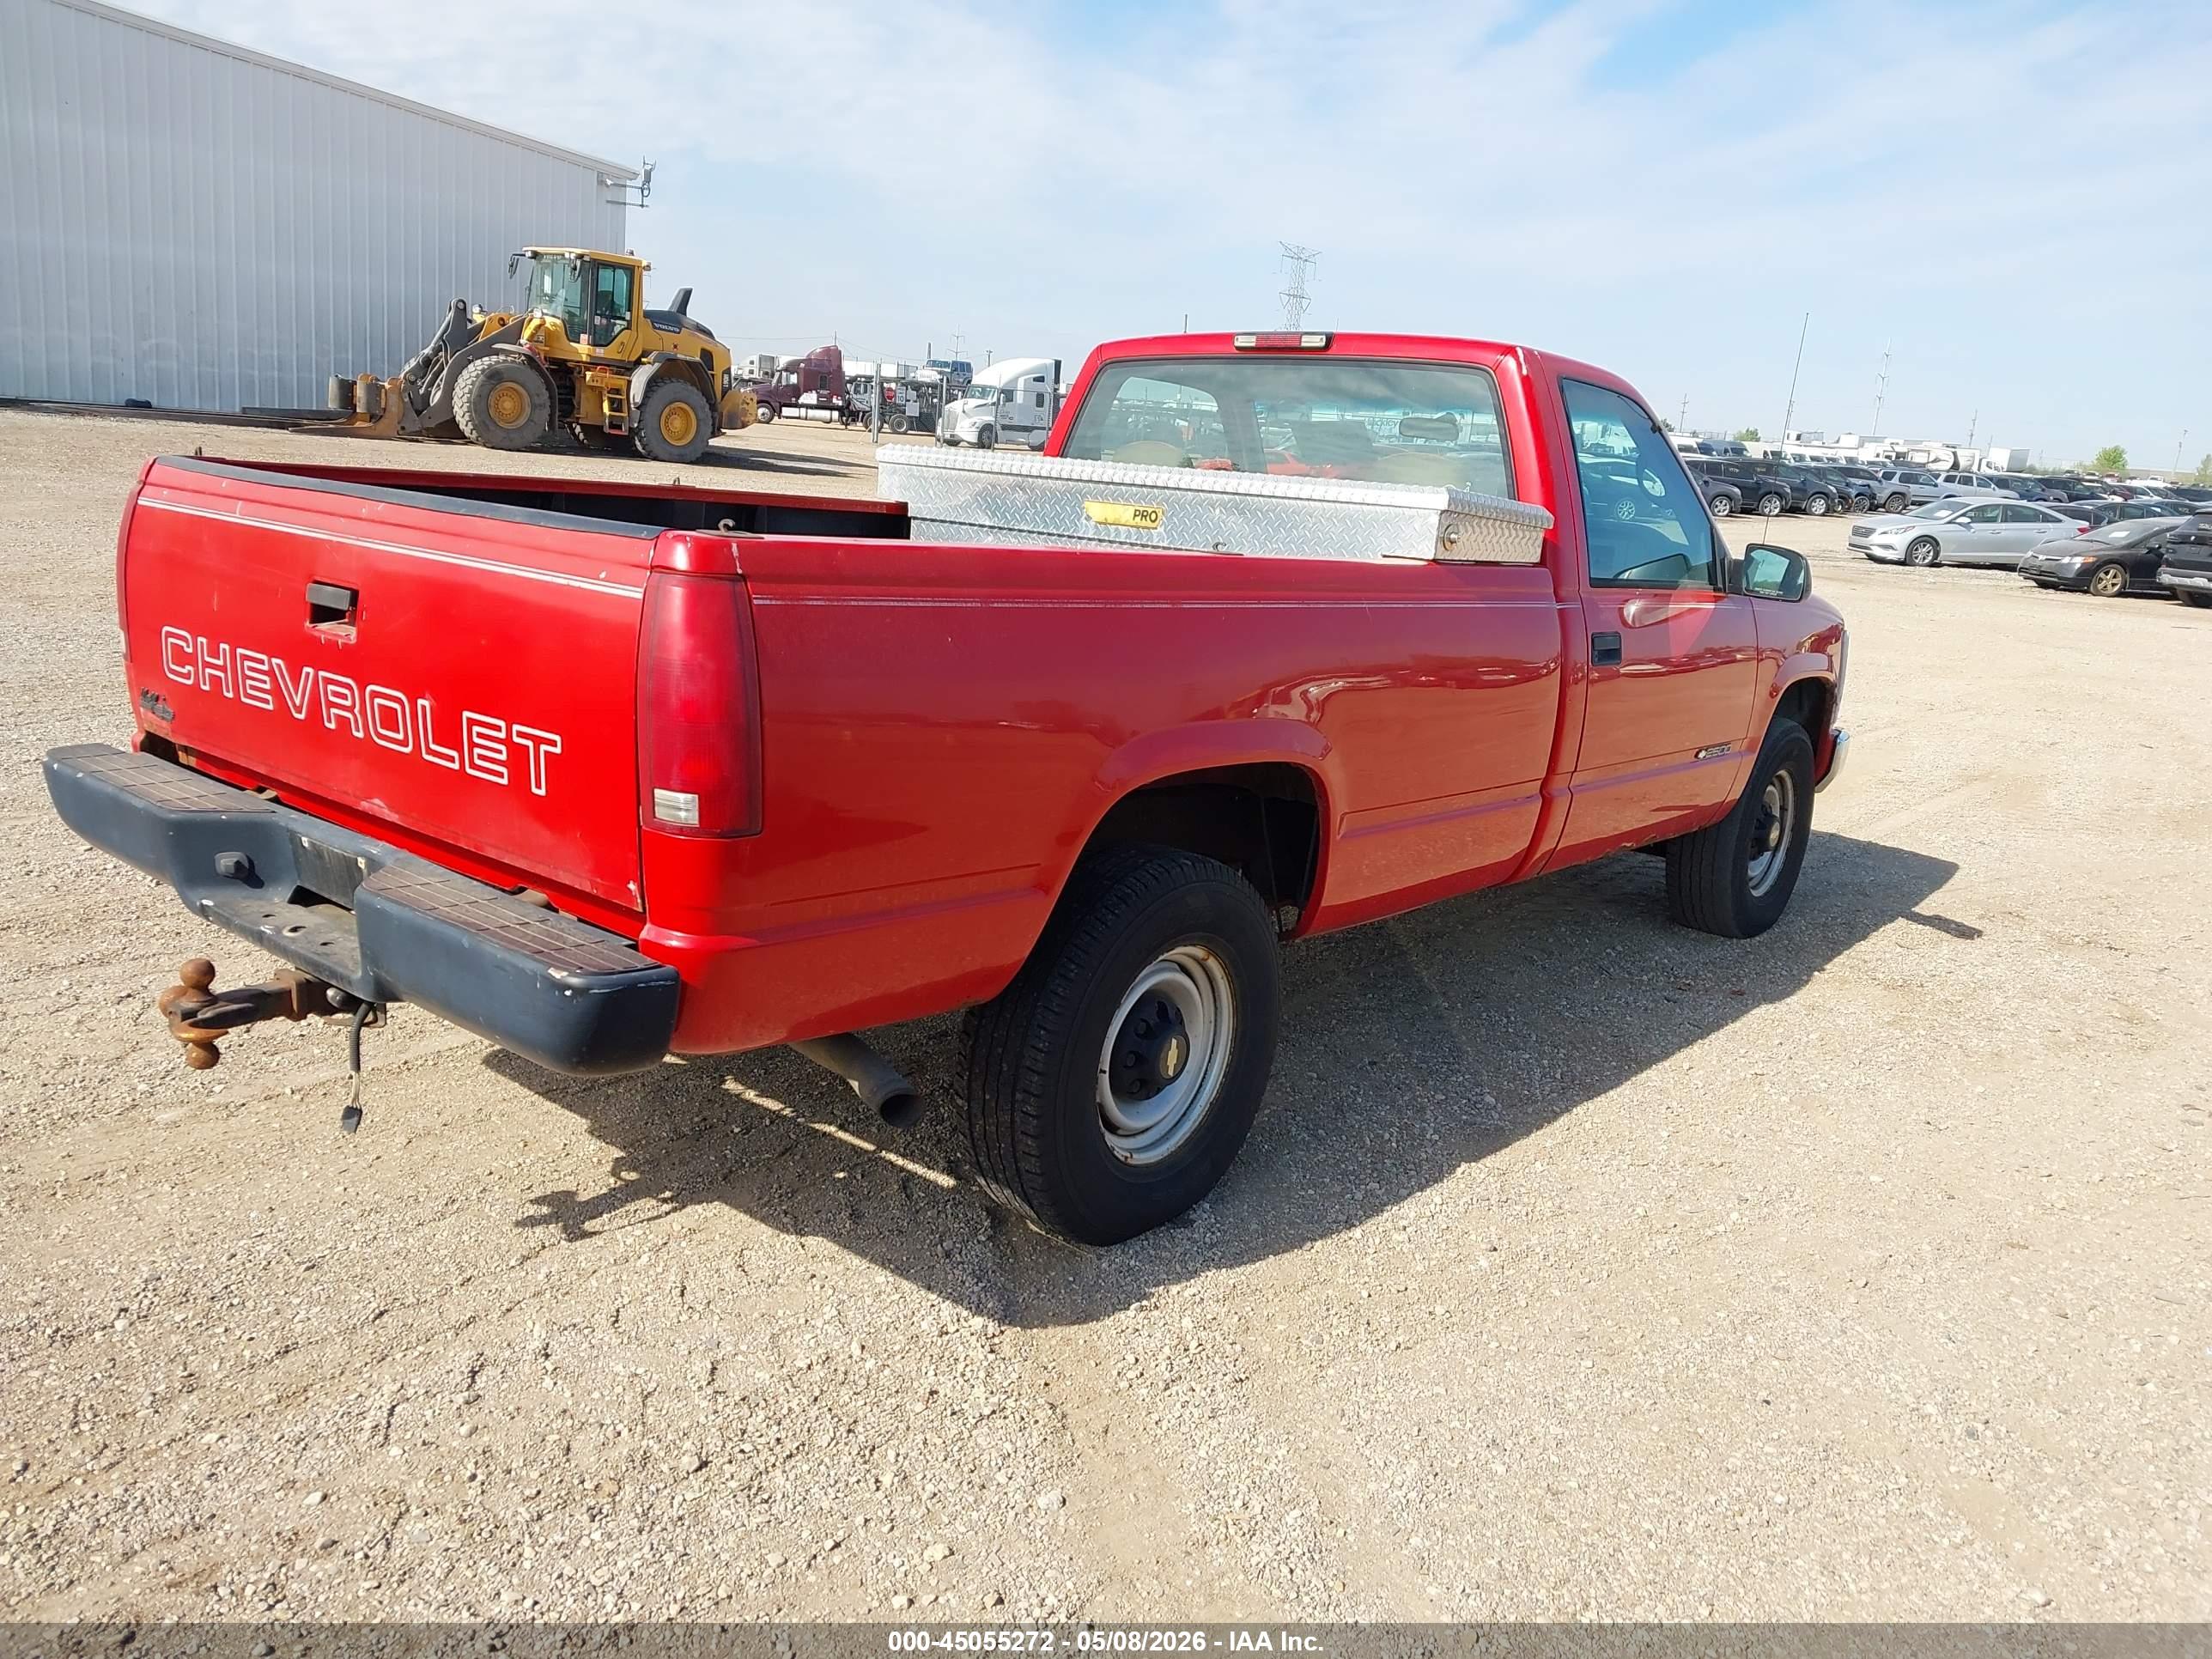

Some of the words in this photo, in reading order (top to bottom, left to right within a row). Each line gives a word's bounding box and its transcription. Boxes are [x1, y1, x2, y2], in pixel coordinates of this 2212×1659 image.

[653, 322, 680, 333] VOLVO
[1133, 508, 1158, 523] PRO
[161, 625, 562, 797] CHEVROLET
